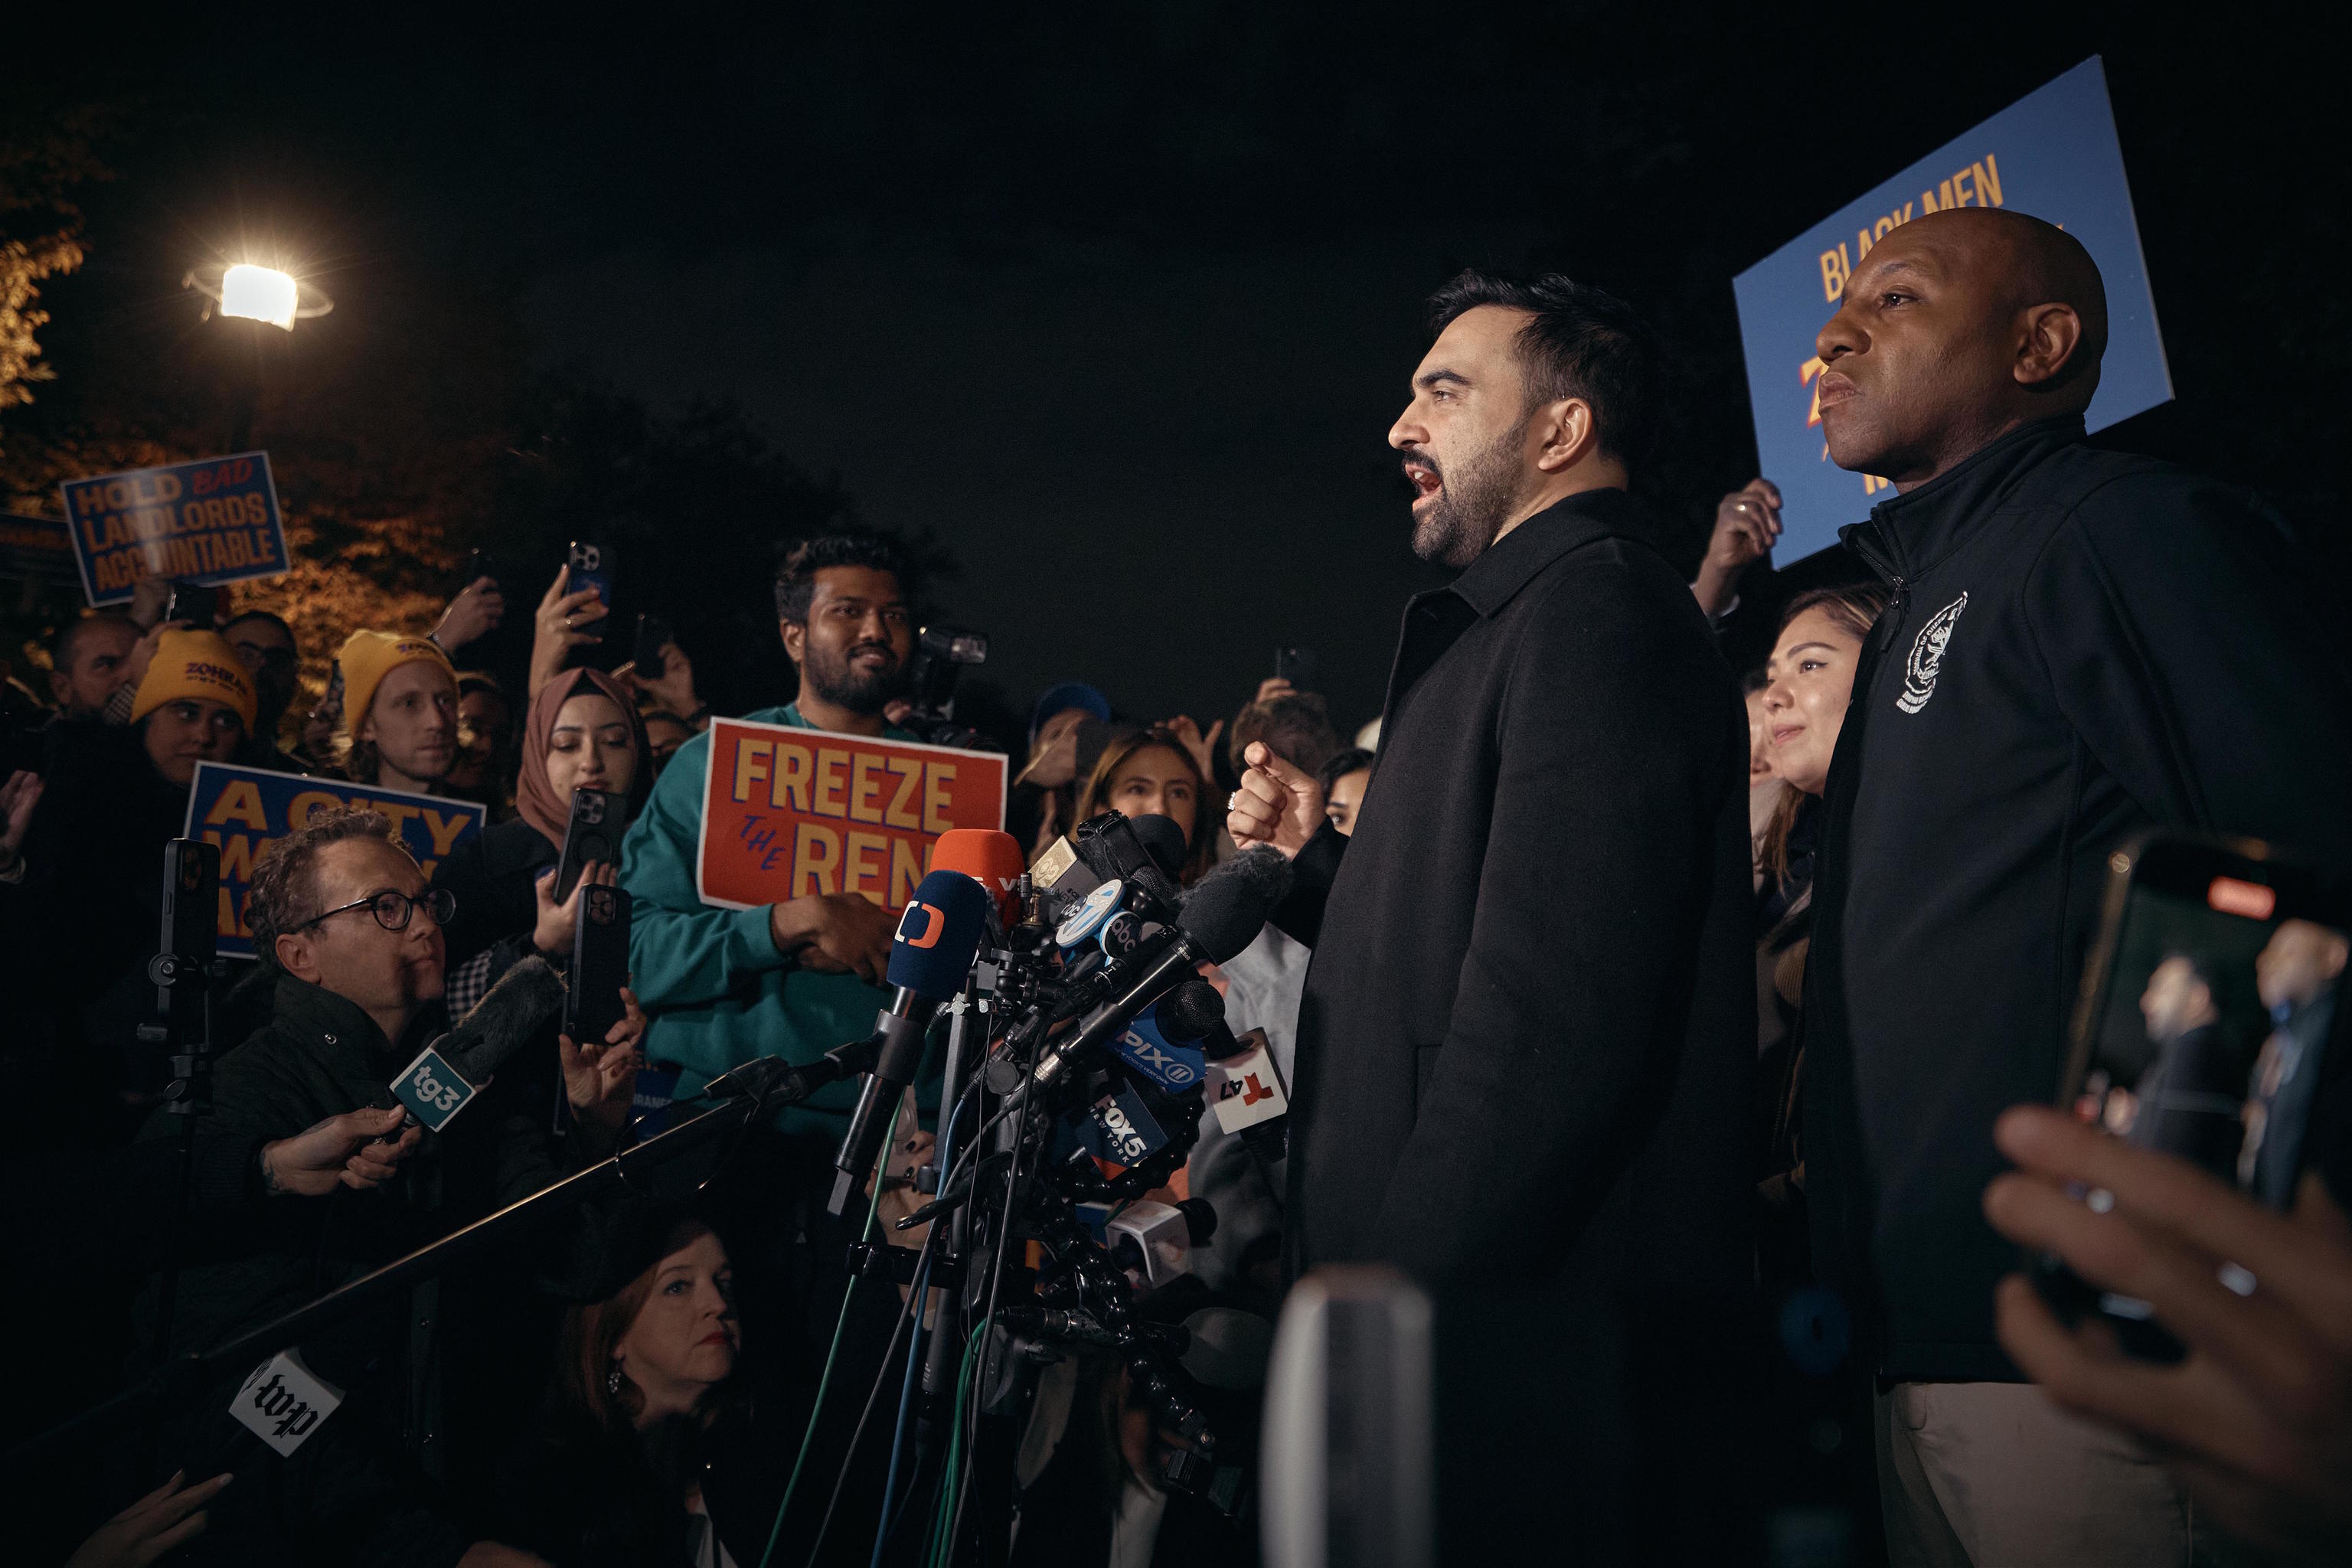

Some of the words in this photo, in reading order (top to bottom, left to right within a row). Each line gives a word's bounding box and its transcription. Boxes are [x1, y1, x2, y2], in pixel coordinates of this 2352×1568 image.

[75, 473, 183, 516] HOLD
[193, 458, 253, 495] BAD
[82, 492, 269, 554] LANDLORDS
[732, 738, 957, 836] FREEZE
[203, 779, 269, 831] A
[286, 789, 472, 857] CTY
[740, 815, 785, 871] THE
[790, 822, 936, 911] REN
[1111, 918, 1137, 953] abc
[413, 1065, 461, 1111] tg3
[1220, 1080, 1243, 1100] 47
[1107, 1132, 1130, 1164] YORK
